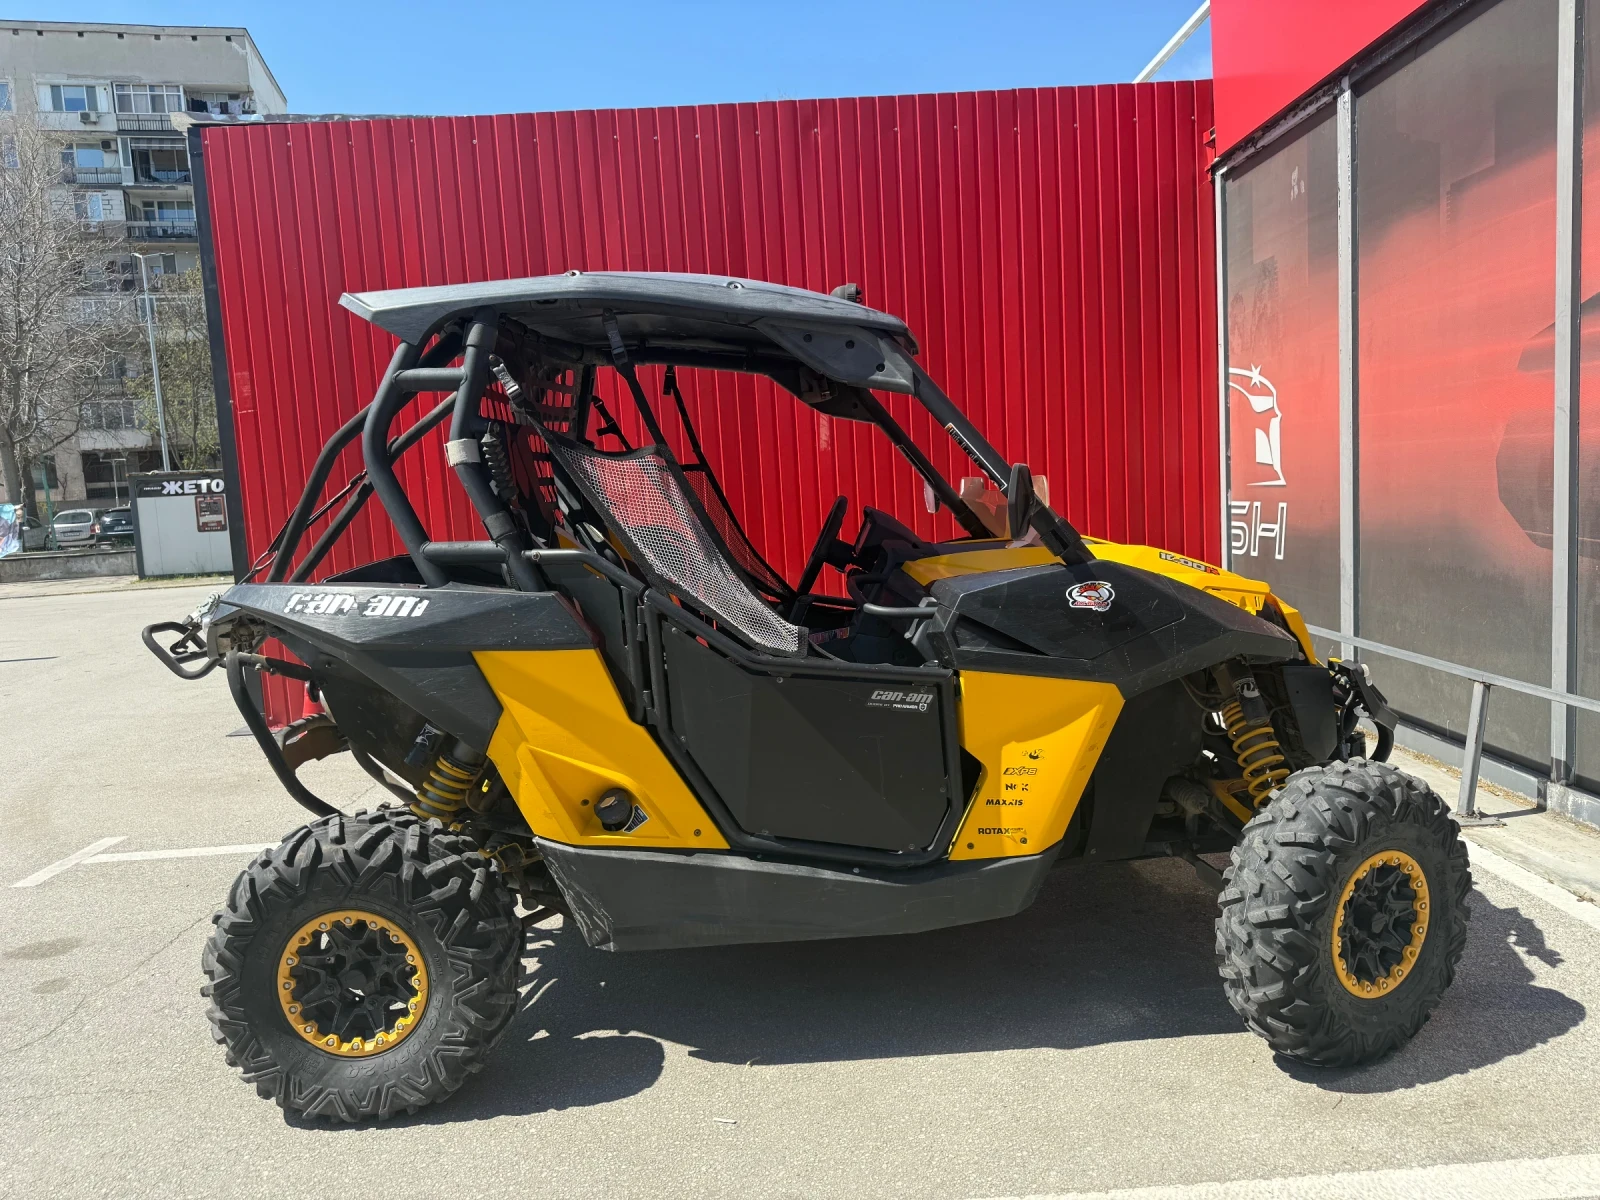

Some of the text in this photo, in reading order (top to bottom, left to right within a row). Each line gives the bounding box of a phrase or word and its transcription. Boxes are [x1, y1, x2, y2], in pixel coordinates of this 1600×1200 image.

[161, 479, 225, 495] ЖЕТО
[871, 690, 934, 704] can-am
[977, 827, 1010, 835] ROTAX
